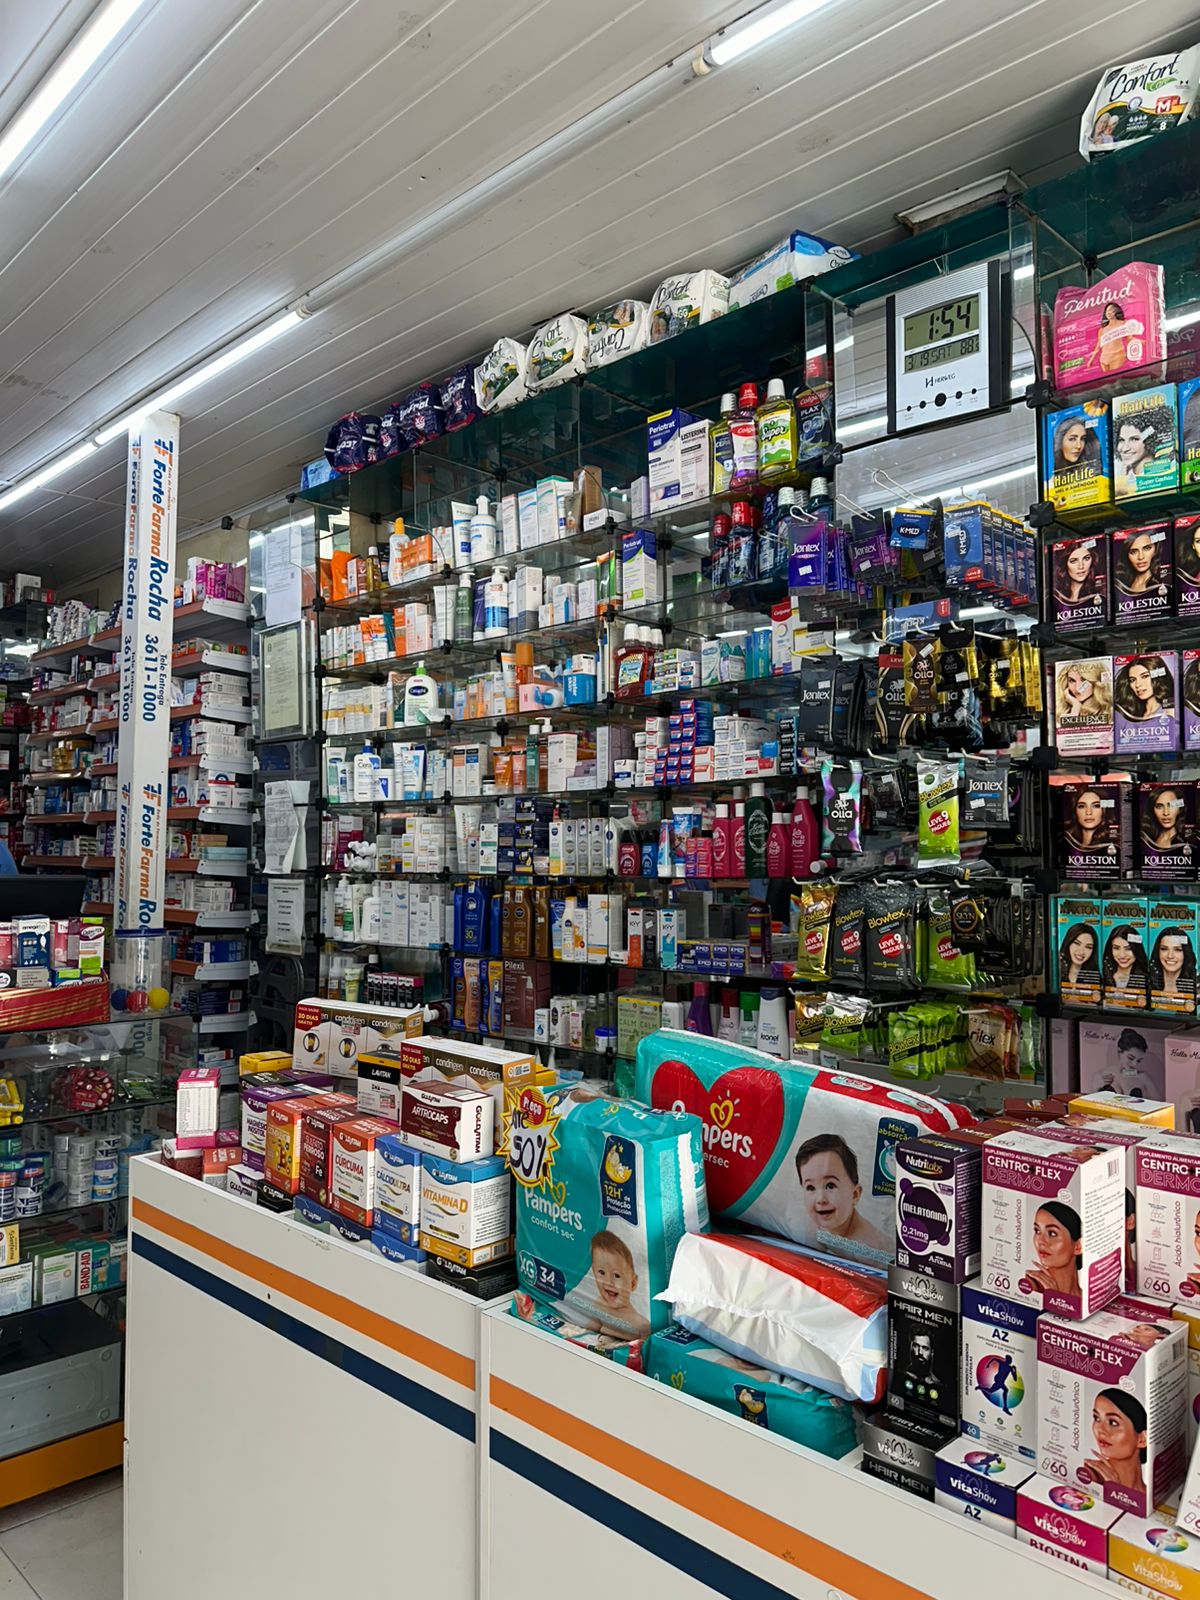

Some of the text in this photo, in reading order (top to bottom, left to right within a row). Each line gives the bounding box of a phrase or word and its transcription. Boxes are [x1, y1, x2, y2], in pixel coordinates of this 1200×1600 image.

[1109, 55, 1180, 102] Confort
[1160, 100, 1171, 113] M
[929, 301, 971, 340] 1:54
[1054, 467, 1094, 488] HairLife
[1119, 596, 1167, 611] KOLESTON
[1057, 606, 1102, 620] KOLESTON
[123, 635, 132, 722] 3611-1000
[143, 634, 158, 722] 3611-1000
[159, 654, 168, 705] Tele Entrega
[914, 671, 934, 679] olla
[1119, 726, 1169, 738] KOLESTON
[831, 810, 853, 819] olla
[928, 810, 949, 828] LEVE 9
[1068, 856, 1117, 866] KOLESTON
[1144, 856, 1192, 866] KOLESTON
[835, 908, 865, 926] Blowtex
[867, 908, 905, 929] Blowtex
[1104, 907, 1146, 918] MAXTON
[1151, 910, 1196, 920] MAXTON
[804, 932, 823, 947] LEVE 9
[841, 931, 860, 946] LEVE 9
[879, 934, 902, 949] LEVE 9
[505, 960, 525, 970] Pilexil
[371, 1020, 404, 1030] condrigen
[823, 1015, 861, 1030] Blowtex
[970, 1028, 996, 1047] rilex
[435, 1057, 464, 1072] condrigen
[469, 1065, 501, 1080] condrigen
[411, 1106, 449, 1125] ARTROCAPS
[888, 1123, 906, 1133] Mais
[303, 1143, 325, 1160] FERROSO
[985, 1148, 1015, 1159] SUPLEMENTO
[1015, 1153, 1041, 1164] ALIMENTAR
[1050, 1161, 1075, 1172] CÁPSULAS
[1139, 1150, 1173, 1161] SUPLEMENTO
[315, 1166, 323, 1177] Fe
[335, 1154, 364, 1175] CÚRCUMA
[905, 1154, 943, 1174] Nutrilabs
[986, 1165, 1045, 1192] DERMO
[422, 1187, 469, 1213] VITAMINA D
[524, 1186, 583, 1231] Pampers
[606, 1196, 631, 1210] Proteção
[903, 1202, 948, 1223] MELATONINA
[531, 1215, 575, 1241] confort sec
[902, 1225, 929, 1240] 0,21mg
[423, 1237, 430, 1249] 60
[898, 1252, 909, 1265] 60
[1174, 1241, 1182, 1268] Ácido
[80, 1252, 91, 1290] BAND-AID
[520, 1254, 536, 1280] XG
[539, 1264, 556, 1287] 34
[994, 1277, 1011, 1290] 60
[1153, 1281, 1171, 1294] 60
[893, 1300, 953, 1326] HAIR MEN
[978, 1304, 1025, 1327] VitaShow
[992, 1328, 1010, 1343] AZ
[1040, 1323, 1072, 1338] SUPLEMENTO
[1072, 1333, 1101, 1347] ALIMENTAR
[1110, 1345, 1139, 1360] CÁPSULAS
[1041, 1342, 1105, 1376] DERMO
[1071, 1430, 1080, 1451] Ácido
[869, 1461, 929, 1494] HAIR MEN
[1050, 1461, 1068, 1477] 60
[950, 1477, 998, 1505] VitaShow
[964, 1505, 982, 1521] AZ
[1033, 1515, 1087, 1548] VitaShow
[1132, 1561, 1184, 1591] VitaShow
